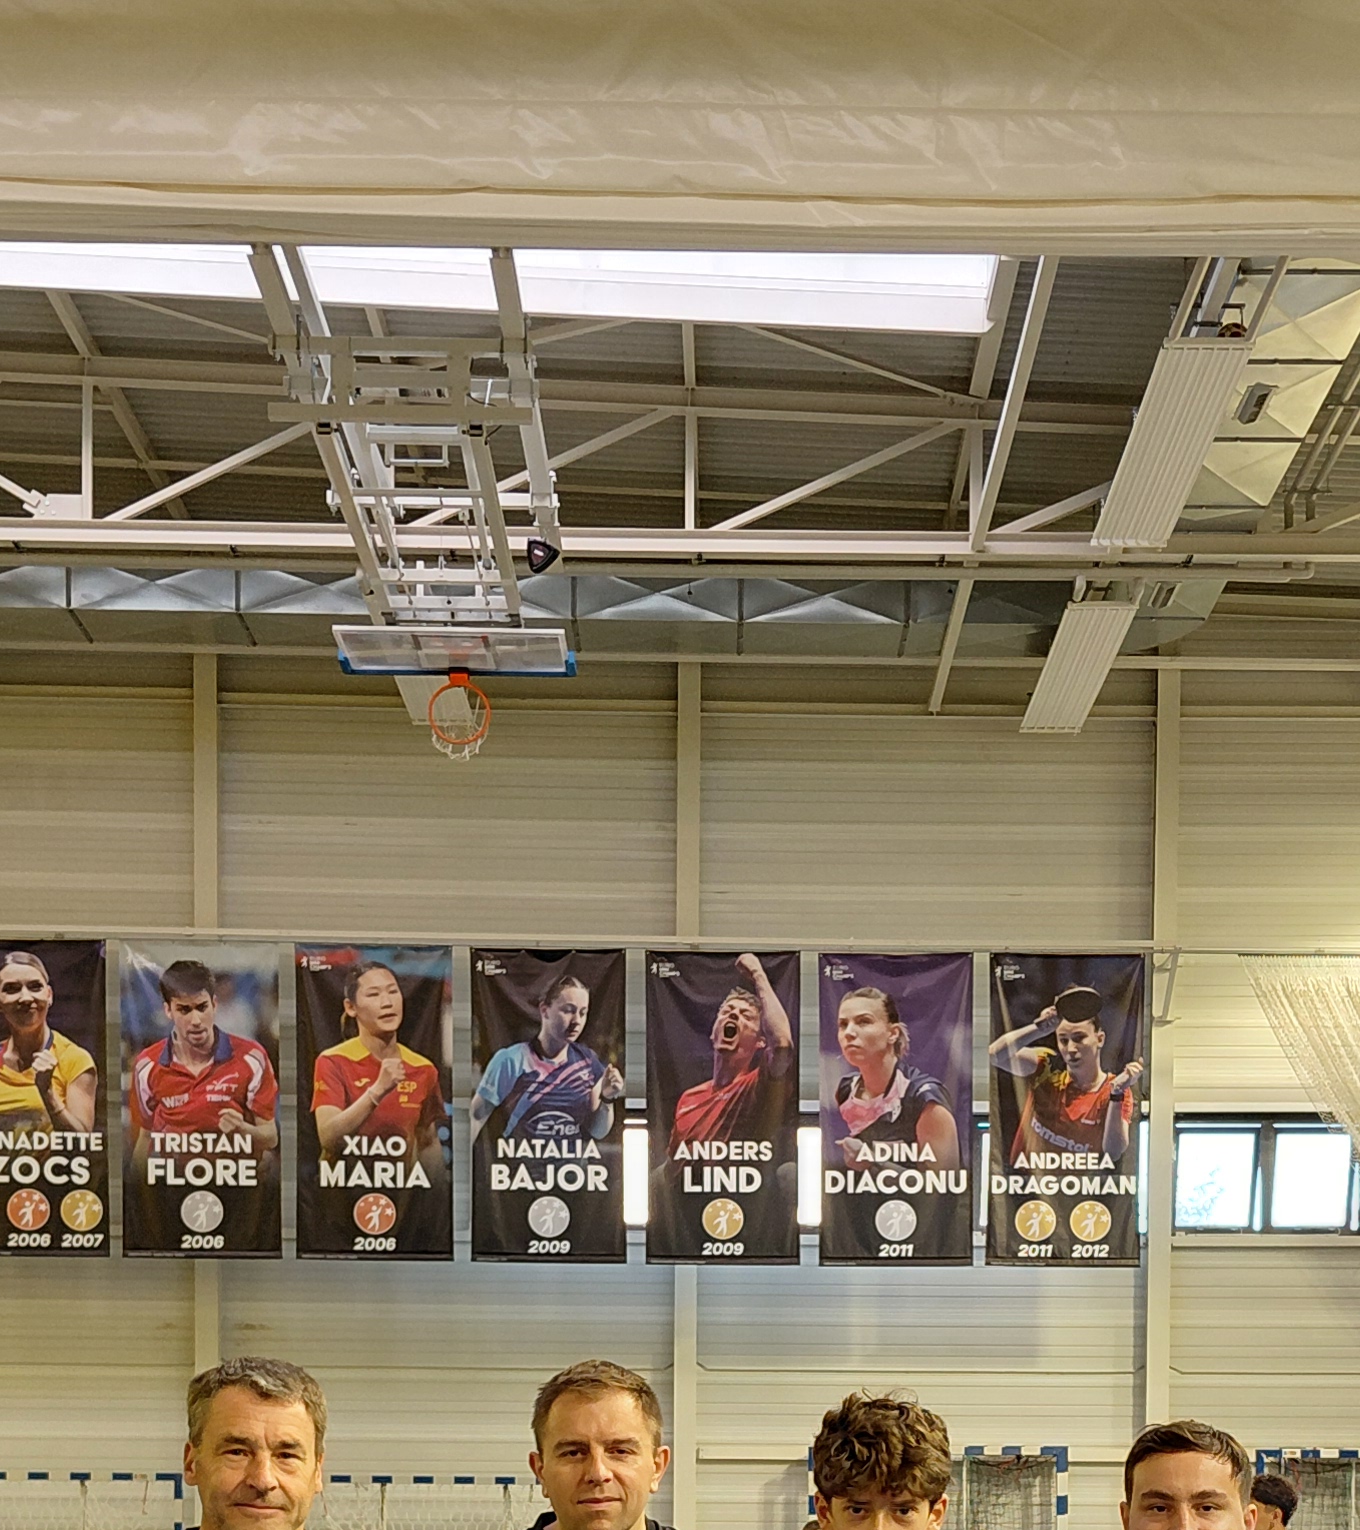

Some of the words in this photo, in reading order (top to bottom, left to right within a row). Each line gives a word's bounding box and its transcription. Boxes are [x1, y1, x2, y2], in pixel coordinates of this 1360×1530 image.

[151, 1132, 252, 1154] TRISTAN
[342, 1135, 407, 1157] XIAO
[497, 1138, 602, 1160] NATALIA
[673, 1140, 774, 1162] ANDERS
[855, 1142, 937, 1163] ADINA
[147, 1158, 258, 1186] FLORE
[1014, 1152, 1115, 1170] ANDREEA
[320, 1160, 432, 1189] MARIA
[490, 1164, 609, 1192] BAJOR
[683, 1166, 763, 1193] LIND
[825, 1169, 968, 1195] DIACONU
[991, 1174, 1137, 1196] DRAGOMAN
[7, 1233, 51, 1248] 2006
[61, 1234, 105, 1249] 2007
[180, 1235, 225, 1249] 2006
[353, 1237, 397, 1251] 2006
[527, 1240, 571, 1254] 2009
[701, 1242, 745, 1256] 2009
[878, 1244, 914, 1258] 2011
[1017, 1244, 1053, 1258] 2011
[1071, 1245, 1110, 1258] 2012
